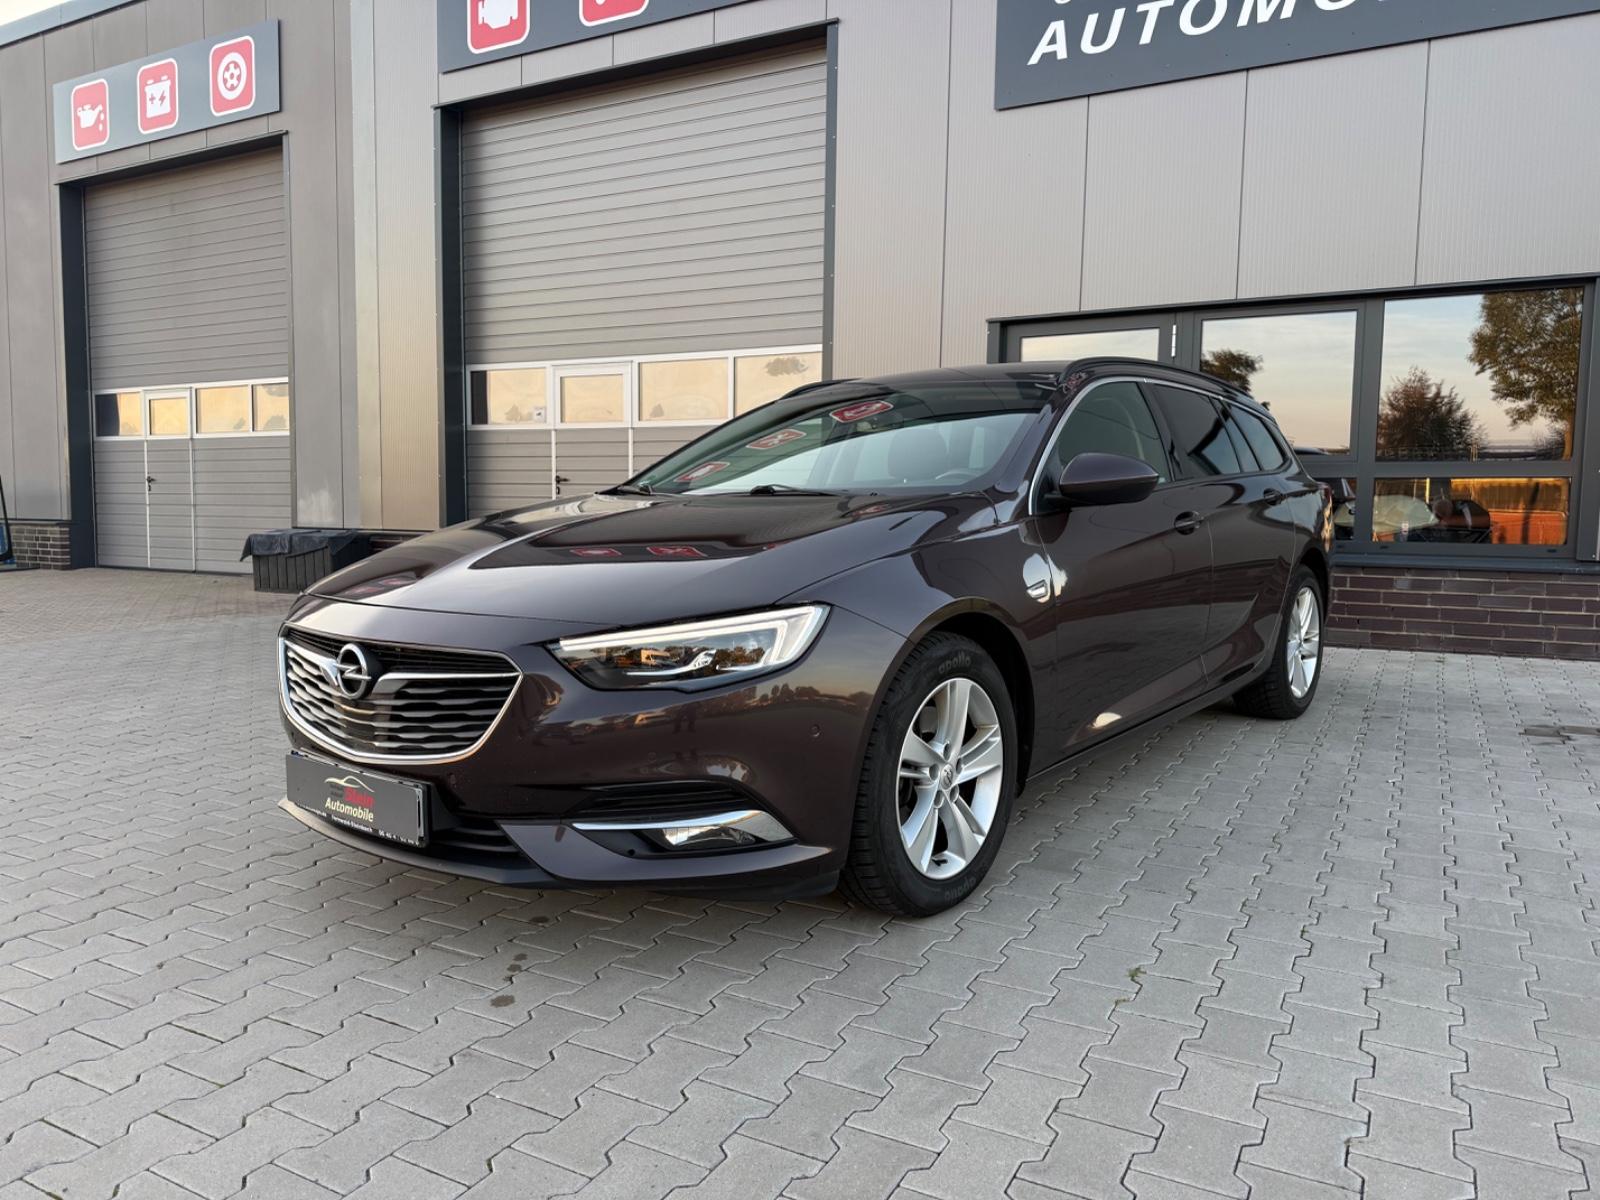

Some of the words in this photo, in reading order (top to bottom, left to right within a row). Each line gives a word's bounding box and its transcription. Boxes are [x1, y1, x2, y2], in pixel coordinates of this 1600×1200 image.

[1027, 0, 1357, 66] AUTOM
[938, 647, 972, 675] apollo
[325, 797, 374, 822] Automobile
